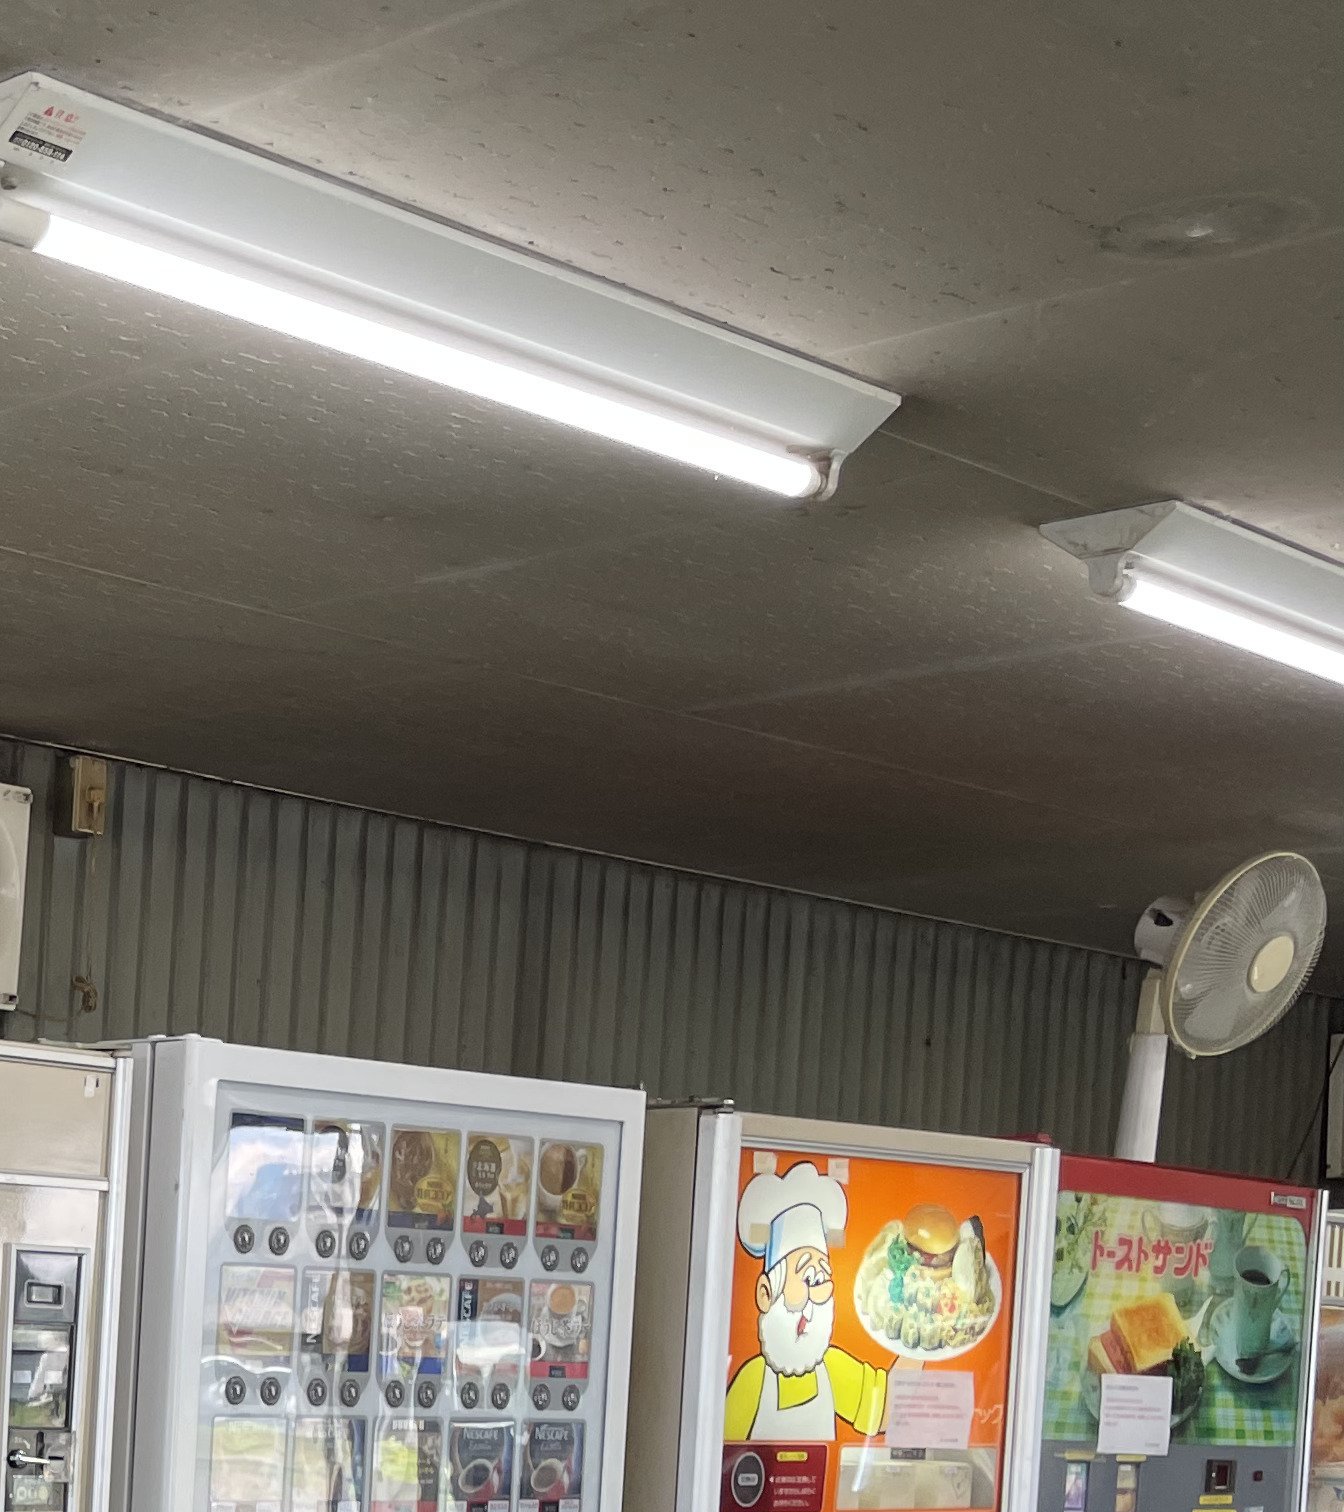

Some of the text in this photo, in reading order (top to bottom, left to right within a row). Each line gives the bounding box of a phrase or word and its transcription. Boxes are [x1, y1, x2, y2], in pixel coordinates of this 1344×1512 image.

[1090, 1230, 1214, 1279] トーストサンド
